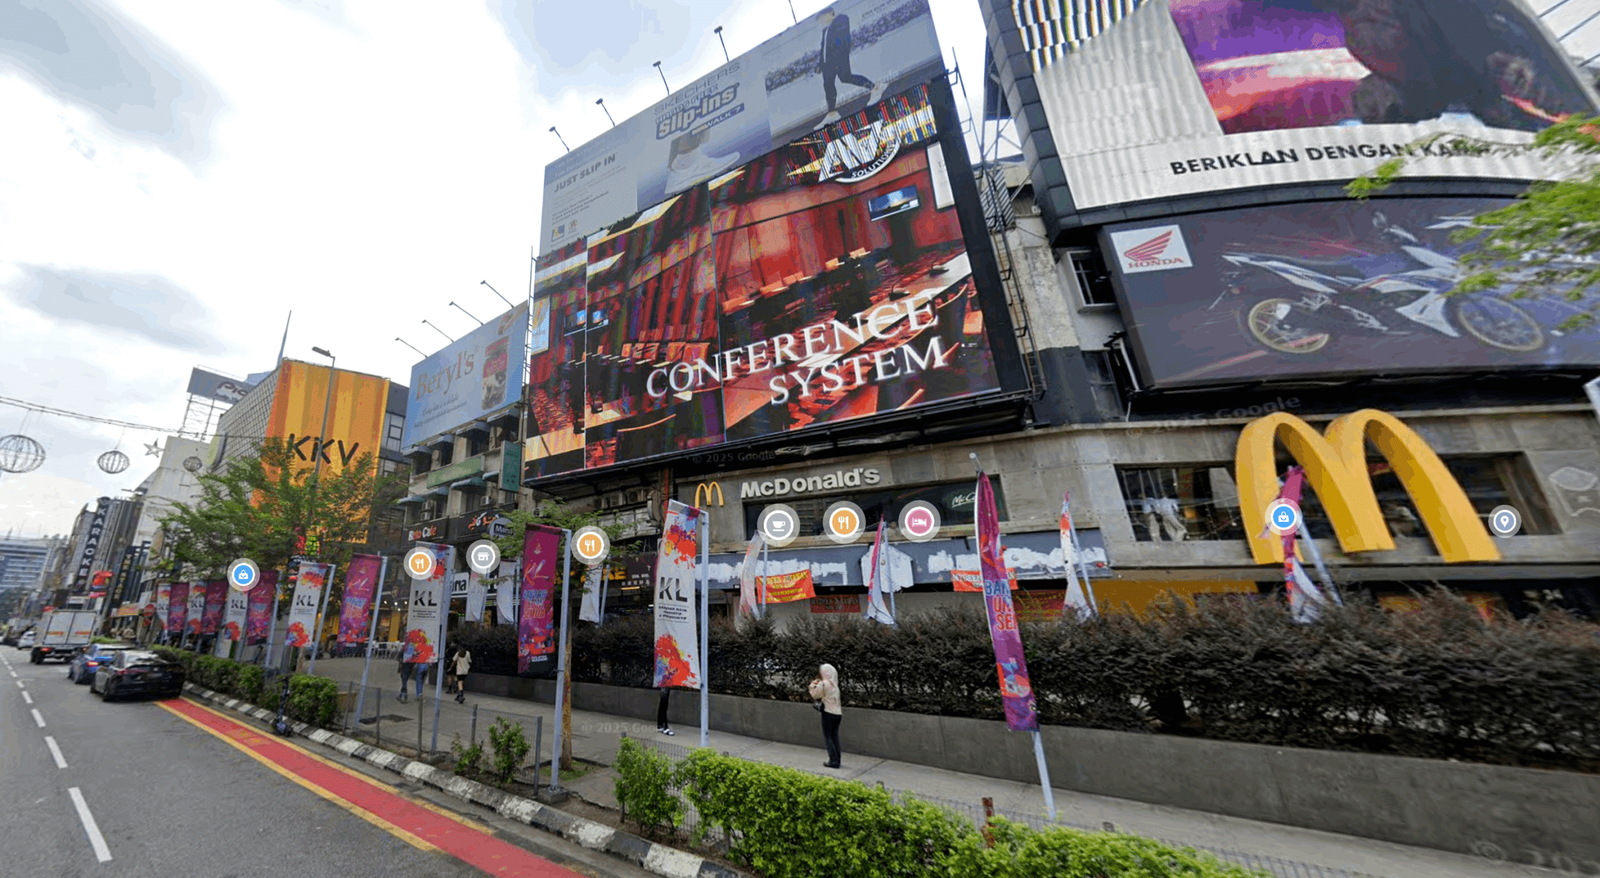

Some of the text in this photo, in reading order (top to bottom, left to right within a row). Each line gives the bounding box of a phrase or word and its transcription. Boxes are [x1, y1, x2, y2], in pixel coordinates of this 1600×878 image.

[655, 62, 740, 115] SKECHERS
[554, 173, 578, 193] JUST
[580, 161, 601, 179] SLIP
[604, 153, 616, 167] IN
[1169, 148, 1299, 175] BERIKLAN
[1304, 142, 1414, 161] DENGAN
[1128, 256, 1184, 269] HONDA
[646, 294, 940, 398] CONFERENCE
[416, 350, 475, 400] Beryl's
[769, 335, 949, 405] SYSTEM
[287, 433, 360, 467] KKV
[740, 467, 881, 500] McDonald's
[79, 507, 107, 577] KARAOKE
[230, 599, 246, 610] KL
[296, 594, 315, 607] KL
[414, 590, 437, 606] KL
[659, 576, 688, 602] KL
